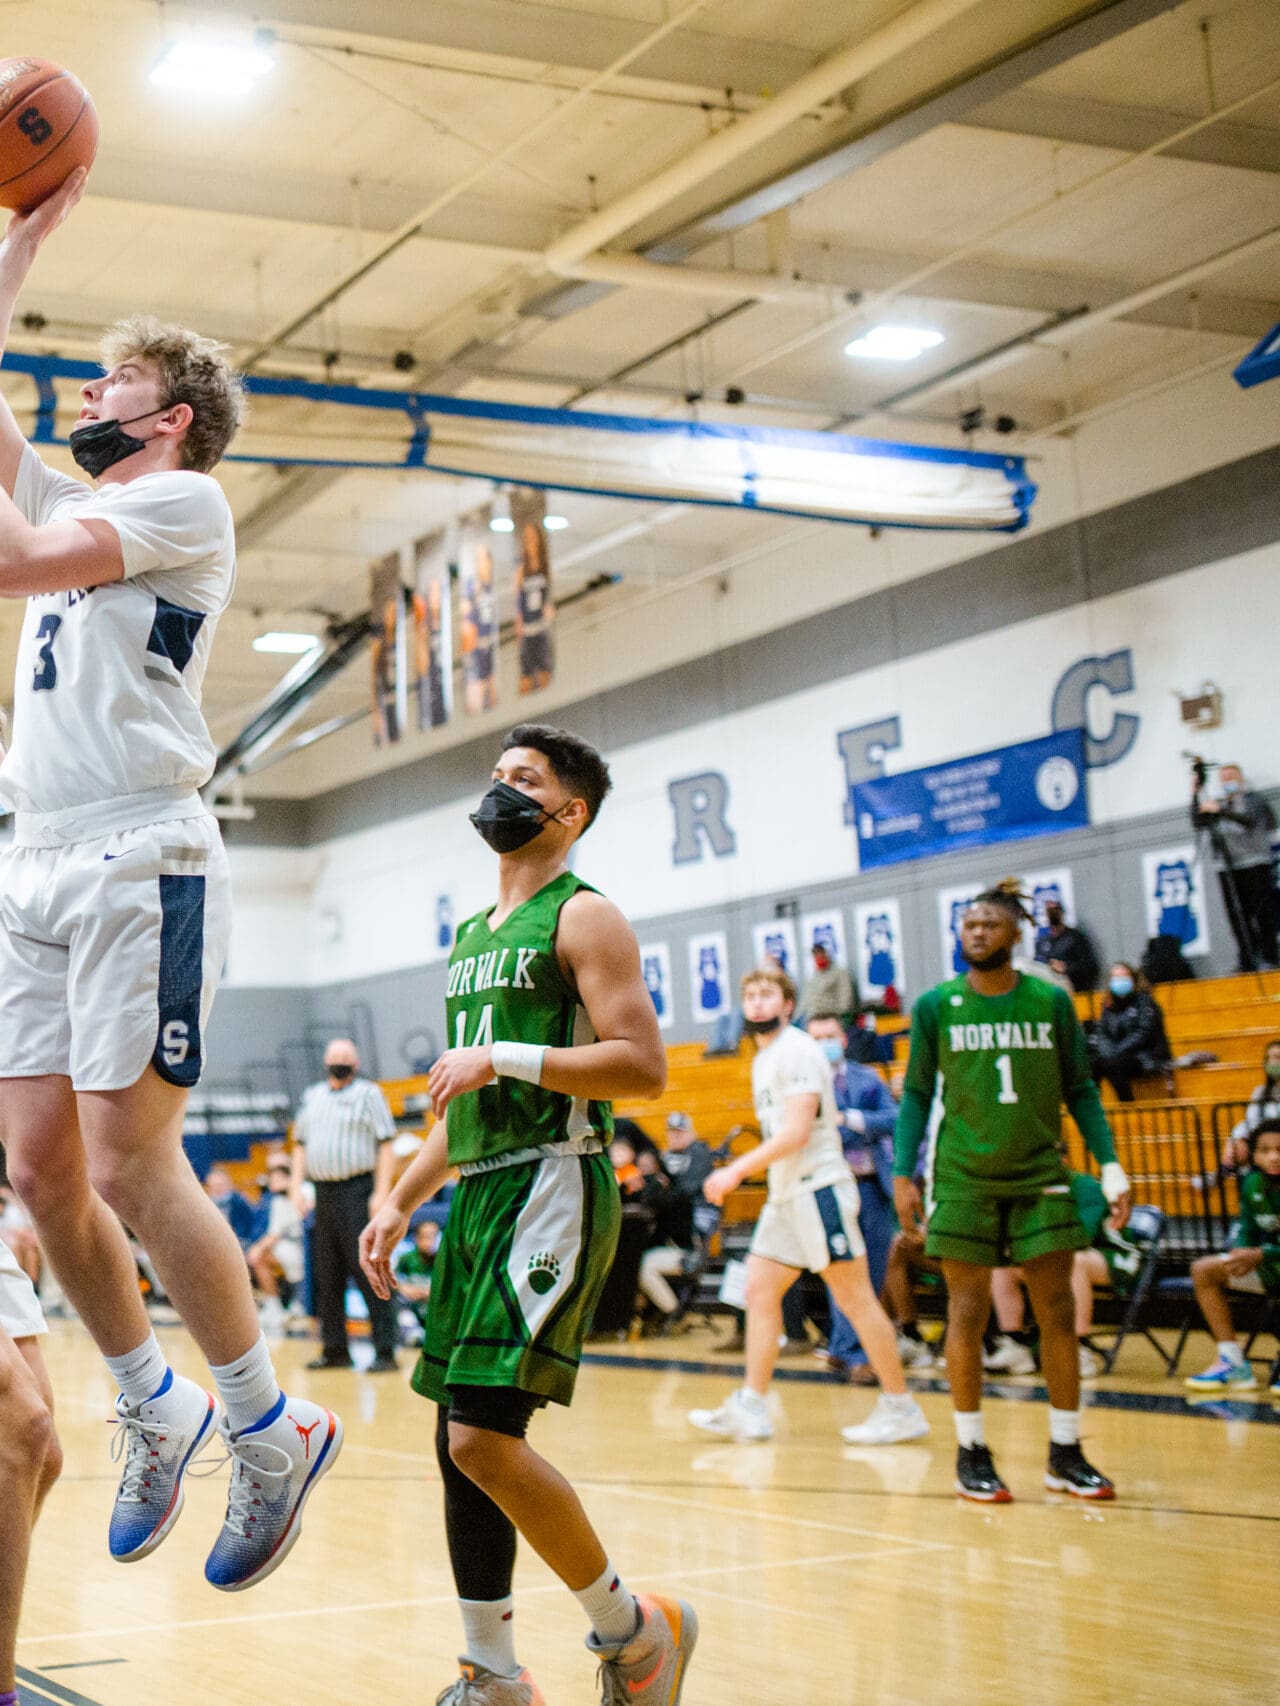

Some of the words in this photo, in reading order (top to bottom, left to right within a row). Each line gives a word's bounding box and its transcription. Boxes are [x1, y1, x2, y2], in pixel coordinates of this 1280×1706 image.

[17, 106, 54, 146] S
[31, 612, 64, 692] 3
[447, 948, 538, 998] ORWALK
[163, 1020, 189, 1066] S
[949, 1021, 1053, 1052] NORWALK
[995, 1054, 1019, 1104] 1
